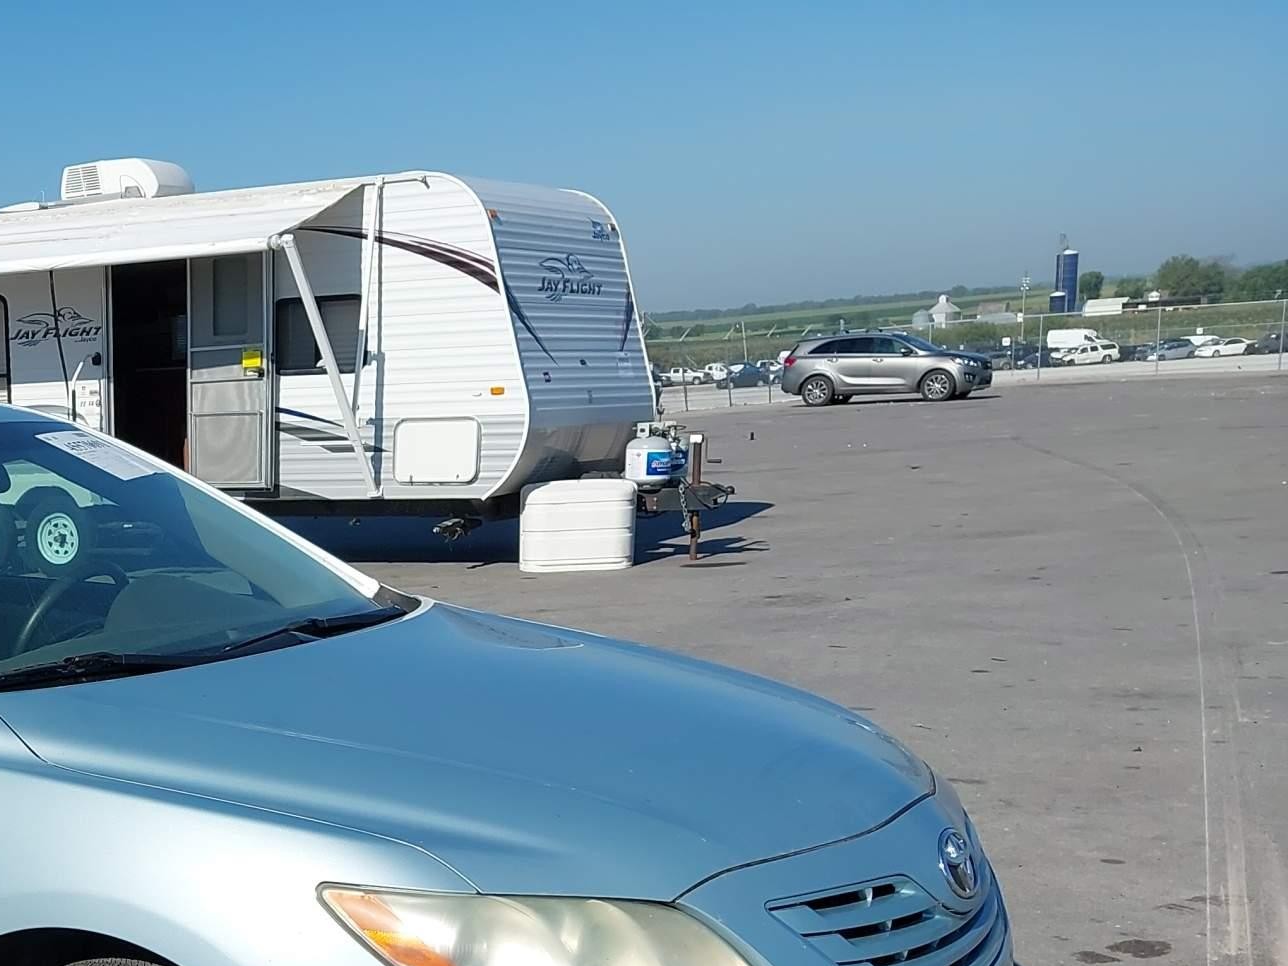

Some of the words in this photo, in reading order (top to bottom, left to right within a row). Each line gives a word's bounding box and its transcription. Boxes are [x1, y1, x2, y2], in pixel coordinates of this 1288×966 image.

[537, 276, 560, 293] JAY
[562, 278, 603, 296] FLIGHT
[10, 328, 41, 341] JAY
[42, 326, 102, 339] FLIGHT
